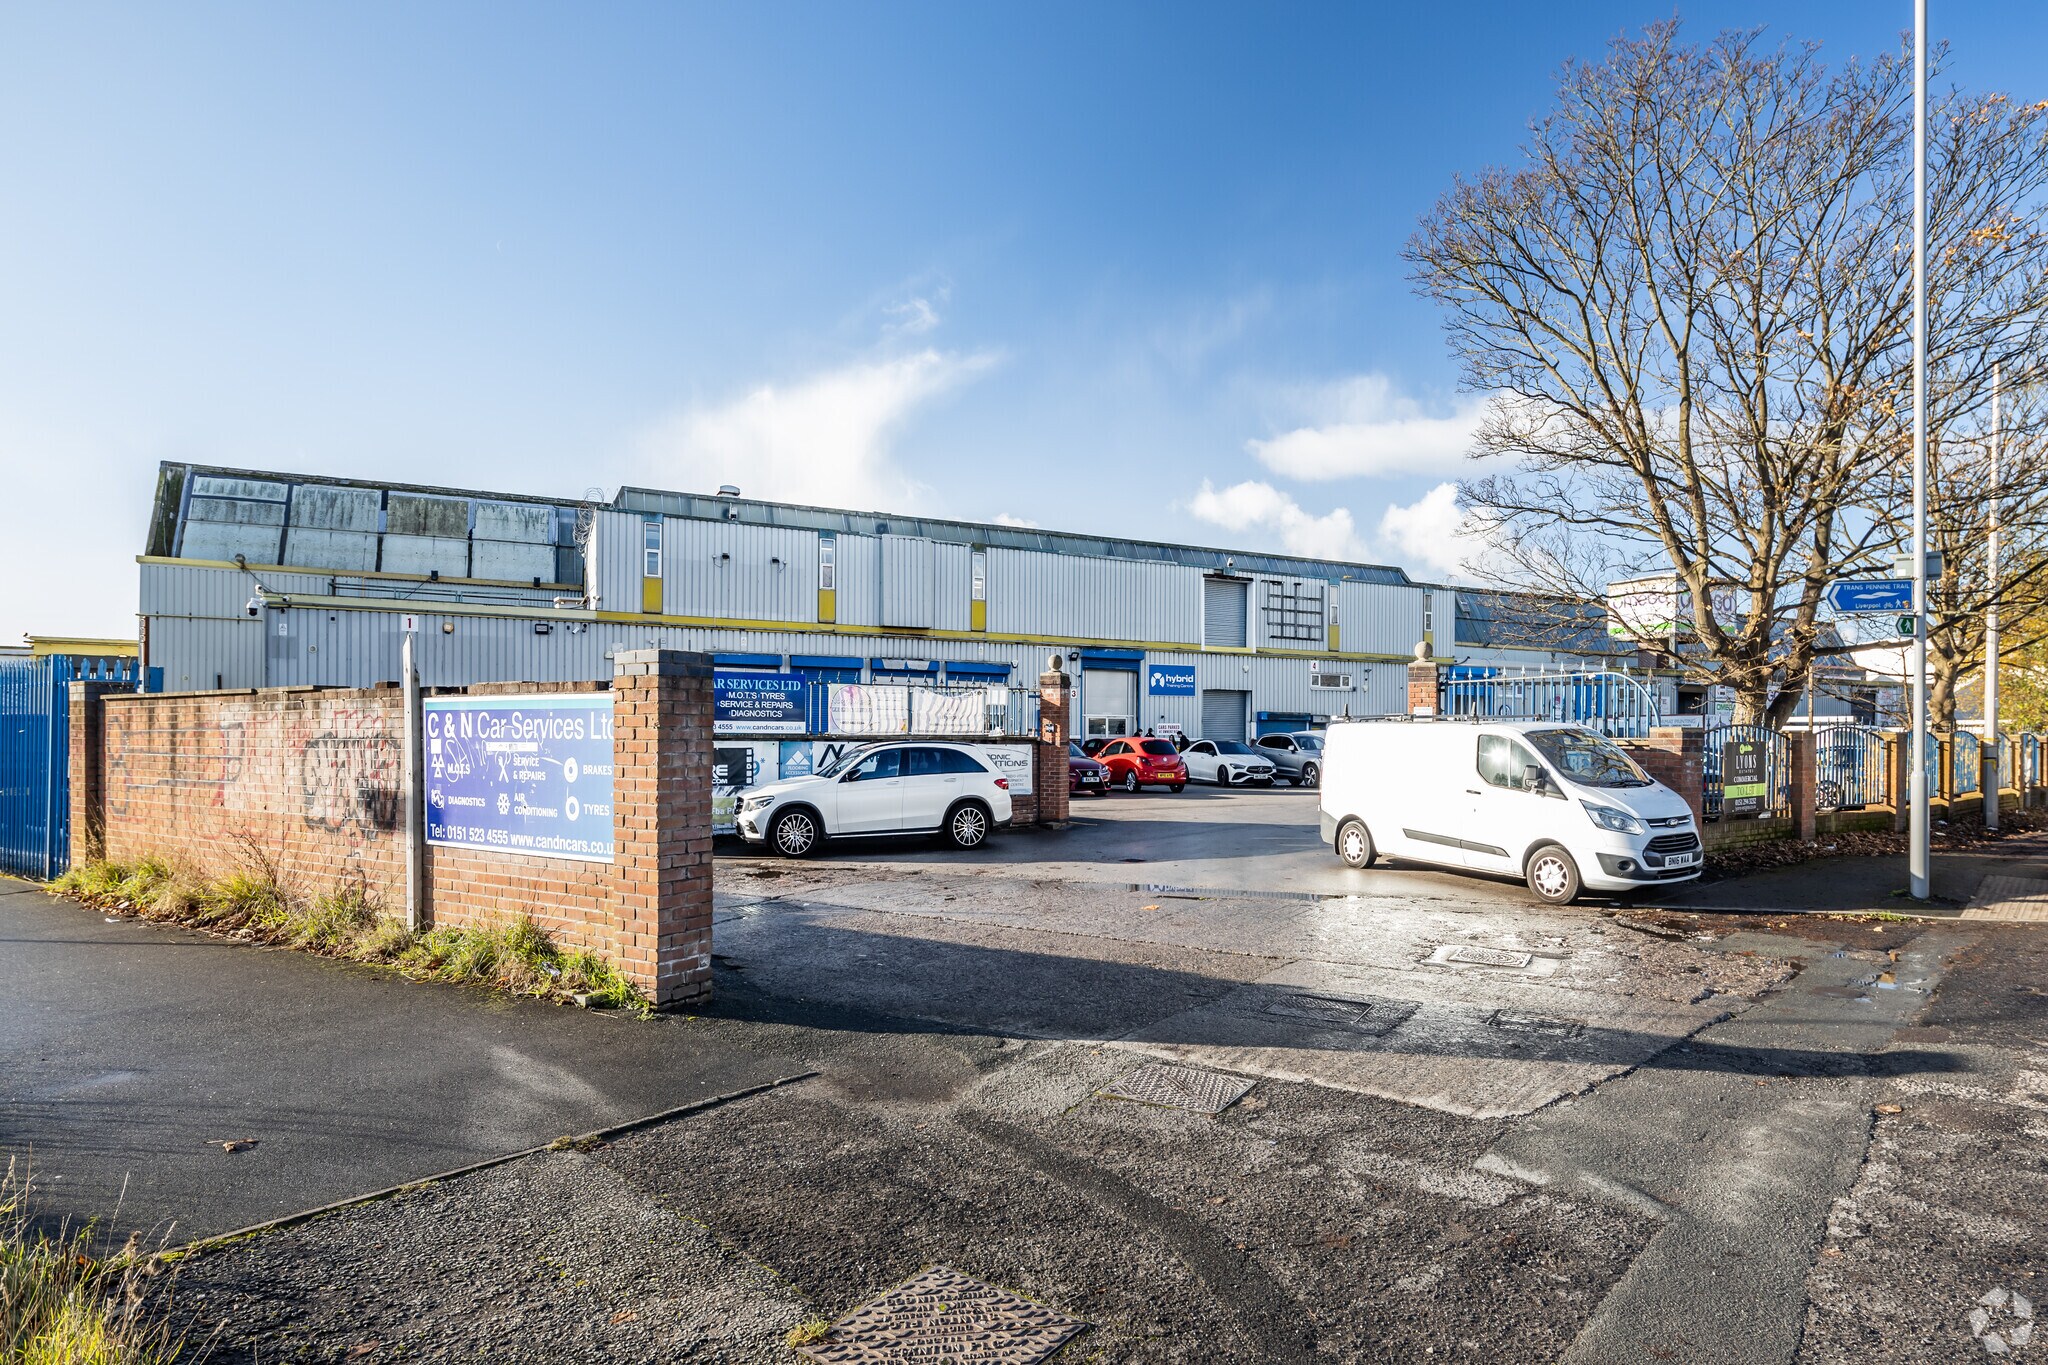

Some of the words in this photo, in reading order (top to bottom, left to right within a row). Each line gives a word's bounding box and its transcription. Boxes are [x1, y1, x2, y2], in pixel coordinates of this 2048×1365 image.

[1855, 602, 1881, 610] Liverpool
[407, 617, 412, 629] 1
[1165, 674, 1194, 684] hybrid
[727, 679, 779, 690] SERVICES
[780, 680, 801, 691] LTD
[760, 692, 785, 700] TYRES
[1071, 690, 1077, 698] 3
[754, 701, 760, 709] &
[761, 701, 793, 709] REPAIRS
[730, 709, 783, 718] DIAGNOSTICS
[427, 712, 439, 739] C
[444, 712, 456, 738] &
[460, 712, 472, 738] N
[477, 711, 507, 739] Car
[511, 711, 585, 740] Services
[513, 756, 539, 767] SERVICE
[1736, 754, 1757, 769] LYONS
[582, 764, 613, 776] BRAKES
[513, 771, 519, 779] &
[519, 771, 546, 782] REPAIRS
[1734, 775, 1758, 783] COMMERCIAL
[1737, 786, 1745, 797] TO
[1745, 785, 1755, 796] LET
[448, 796, 486, 807] DIAGNOSTICS
[513, 792, 525, 802] AIR
[514, 806, 558, 818] CONDITIONING
[583, 803, 610, 817] TYRES
[430, 823, 446, 838] Tel:
[447, 825, 467, 841] 0151
[469, 828, 485, 843] 523
[487, 830, 509, 845] 4555
[511, 833, 614, 855] www.candncars.co.u
